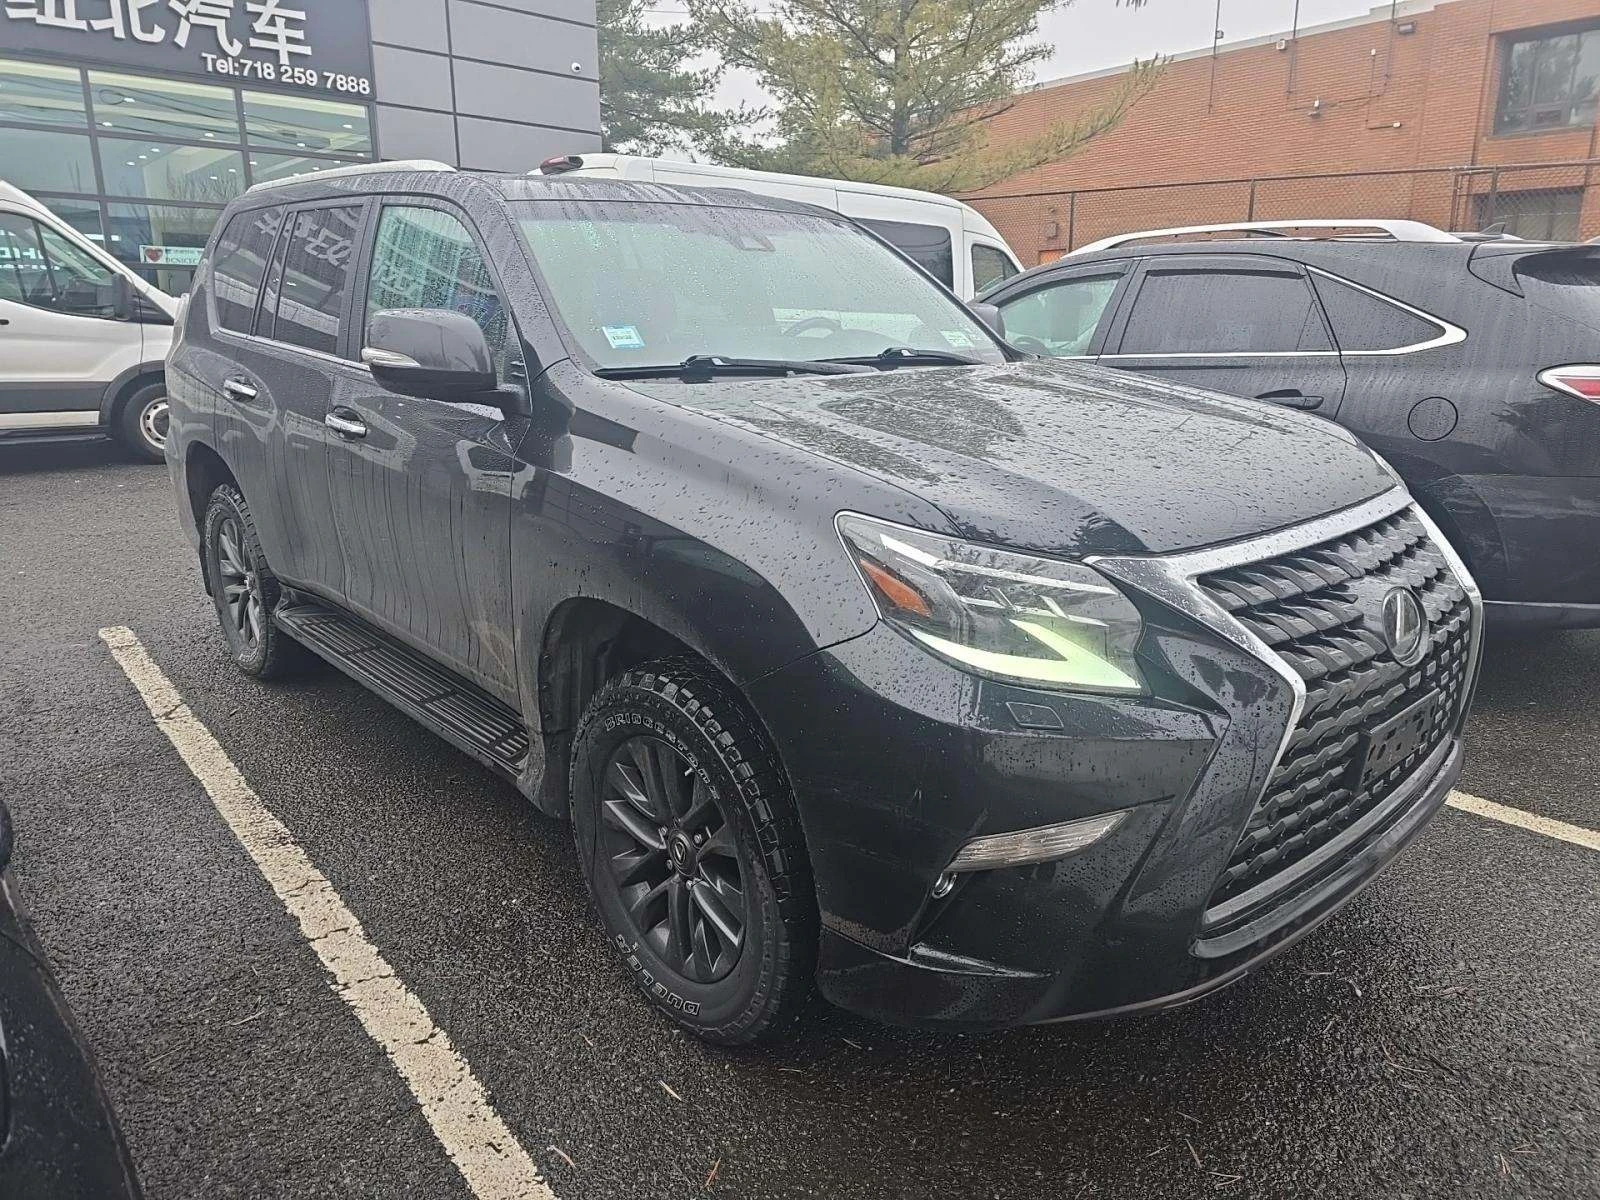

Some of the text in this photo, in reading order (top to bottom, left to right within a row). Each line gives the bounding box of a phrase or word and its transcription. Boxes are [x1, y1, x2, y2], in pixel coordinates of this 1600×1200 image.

[201, 52, 371, 95] Tel:718 259 7888
[615, 934, 701, 1016] DUELER
